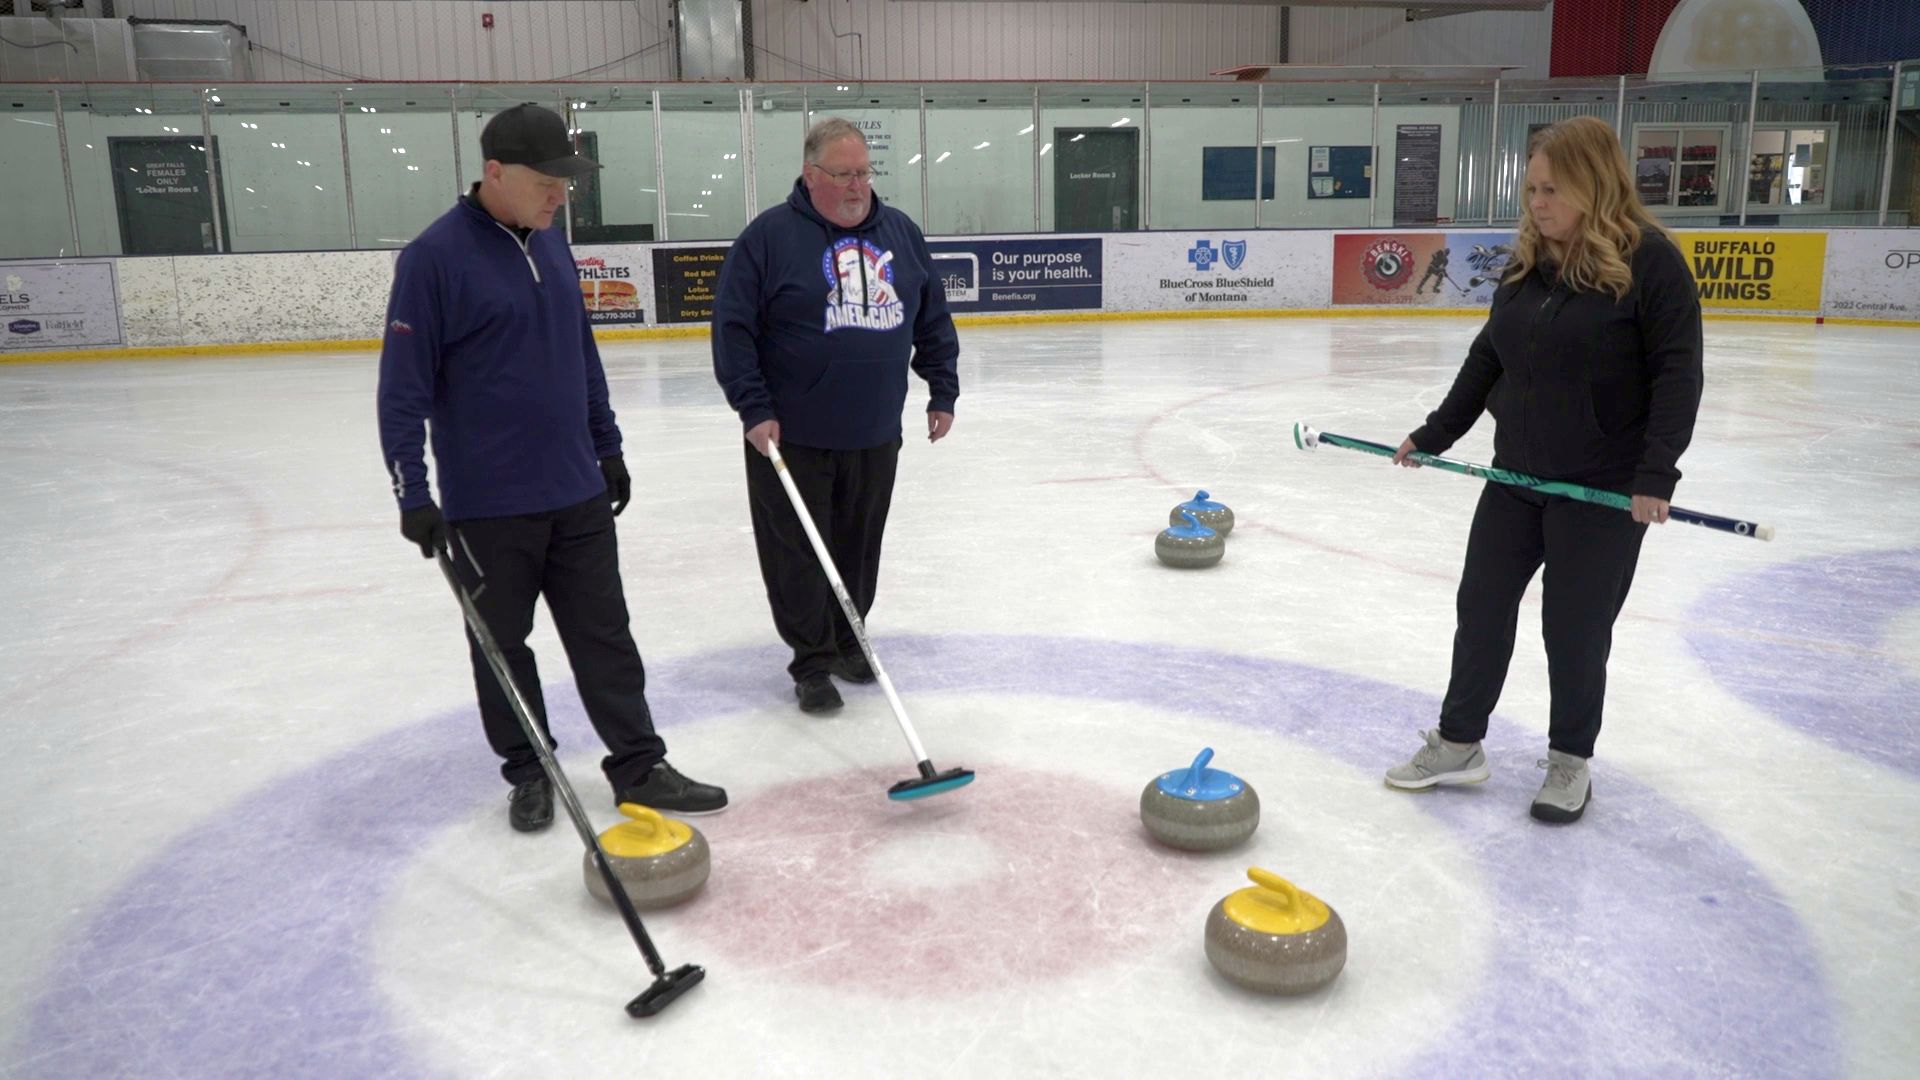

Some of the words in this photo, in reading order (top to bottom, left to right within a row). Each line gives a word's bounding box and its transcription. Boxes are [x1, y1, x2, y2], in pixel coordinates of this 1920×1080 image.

[146, 169, 187, 177] FEMALES
[139, 186, 166, 194] Locker
[1694, 241, 1776, 255] BUFFALO
[992, 251, 1020, 265] Our
[1023, 252, 1082, 267] purpose
[701, 269, 716, 277] Bull
[992, 268, 1005, 281] is
[1008, 270, 1041, 283] your
[1044, 266, 1093, 280] health.
[1693, 256, 1775, 281] WILD
[1159, 278, 1214, 289] BlueCross
[1216, 277, 1275, 288] BlueShield
[1184, 292, 1197, 302] of
[1198, 292, 1248, 302] Montana
[1695, 282, 1772, 301] WINGS
[1855, 302, 1888, 310] Central
[680, 310, 699, 318] Dirty
[825, 301, 905, 333] AMERICANS
